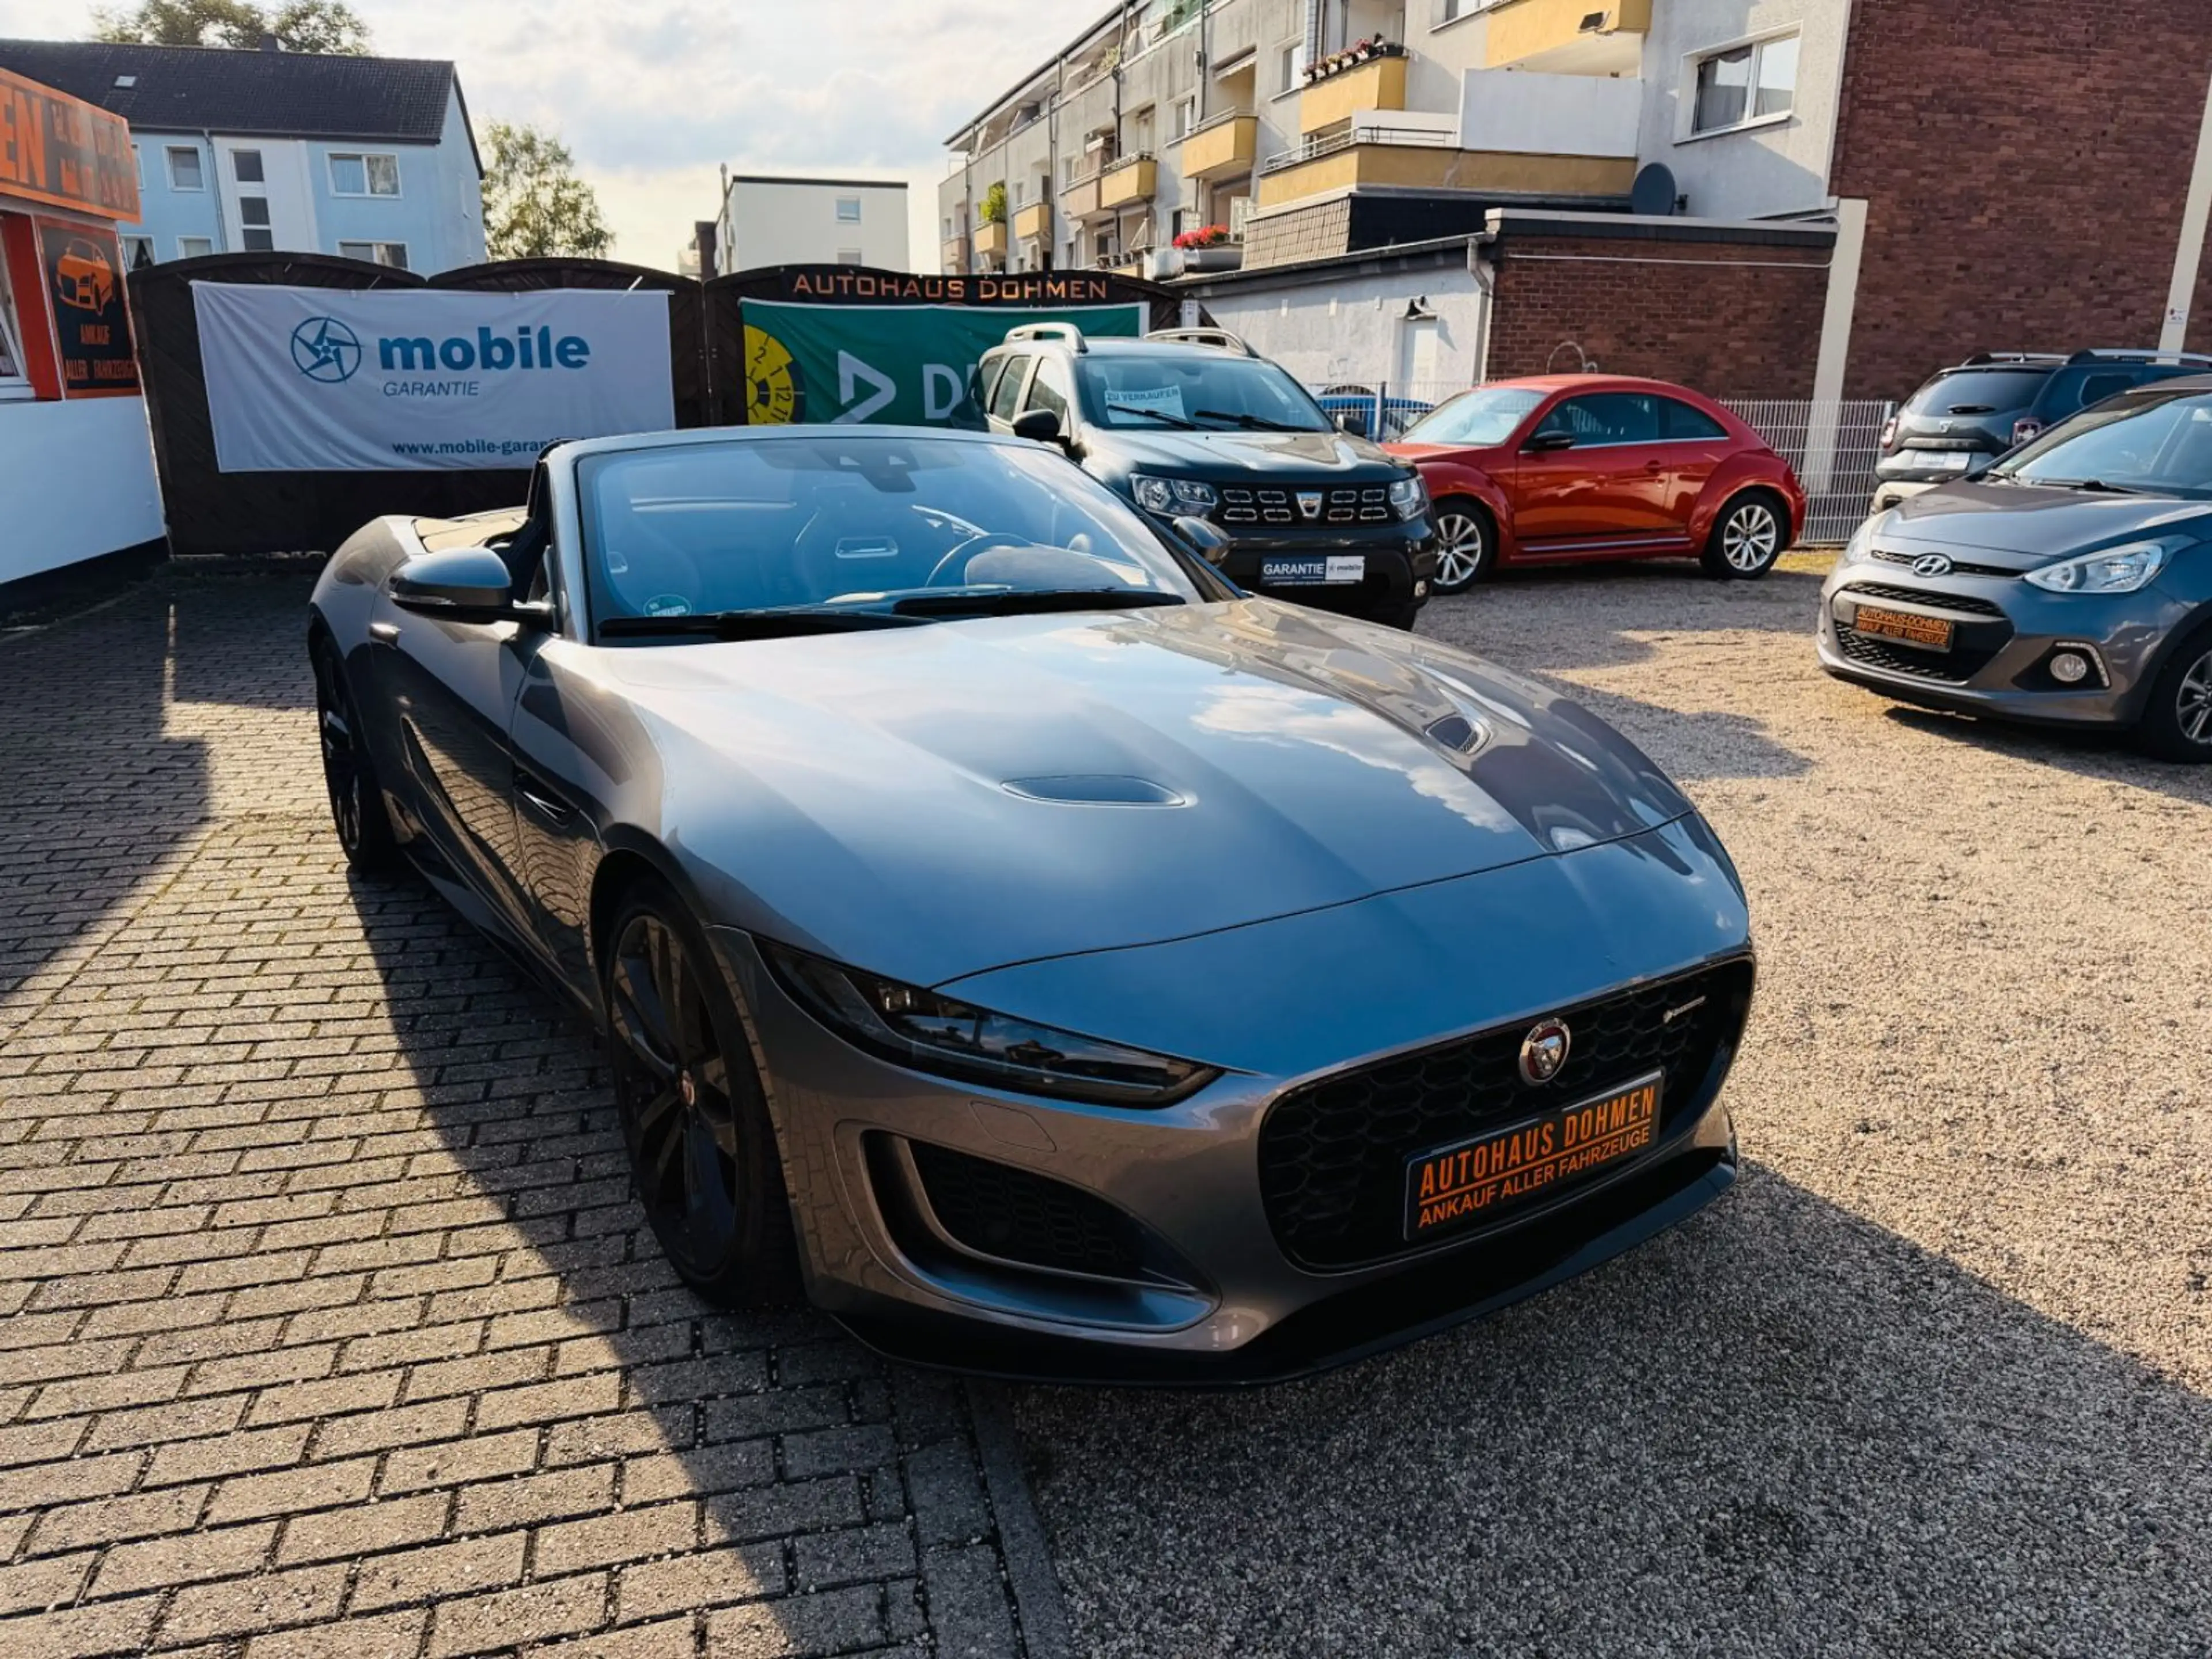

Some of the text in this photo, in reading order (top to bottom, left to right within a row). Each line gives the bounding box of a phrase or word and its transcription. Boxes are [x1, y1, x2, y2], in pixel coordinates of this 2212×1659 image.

[793, 274, 1106, 299] AUTOHAUS DOHMEN
[378, 325, 590, 370] mobile
[383, 381, 479, 397] GARANTIE
[1263, 563, 1325, 575] GARANTIE
[1419, 1085, 1655, 1198] AUTOHAUS DOHMEN
[1418, 1126, 1651, 1228] ANKAUF ALLER FAHRZEUGE
